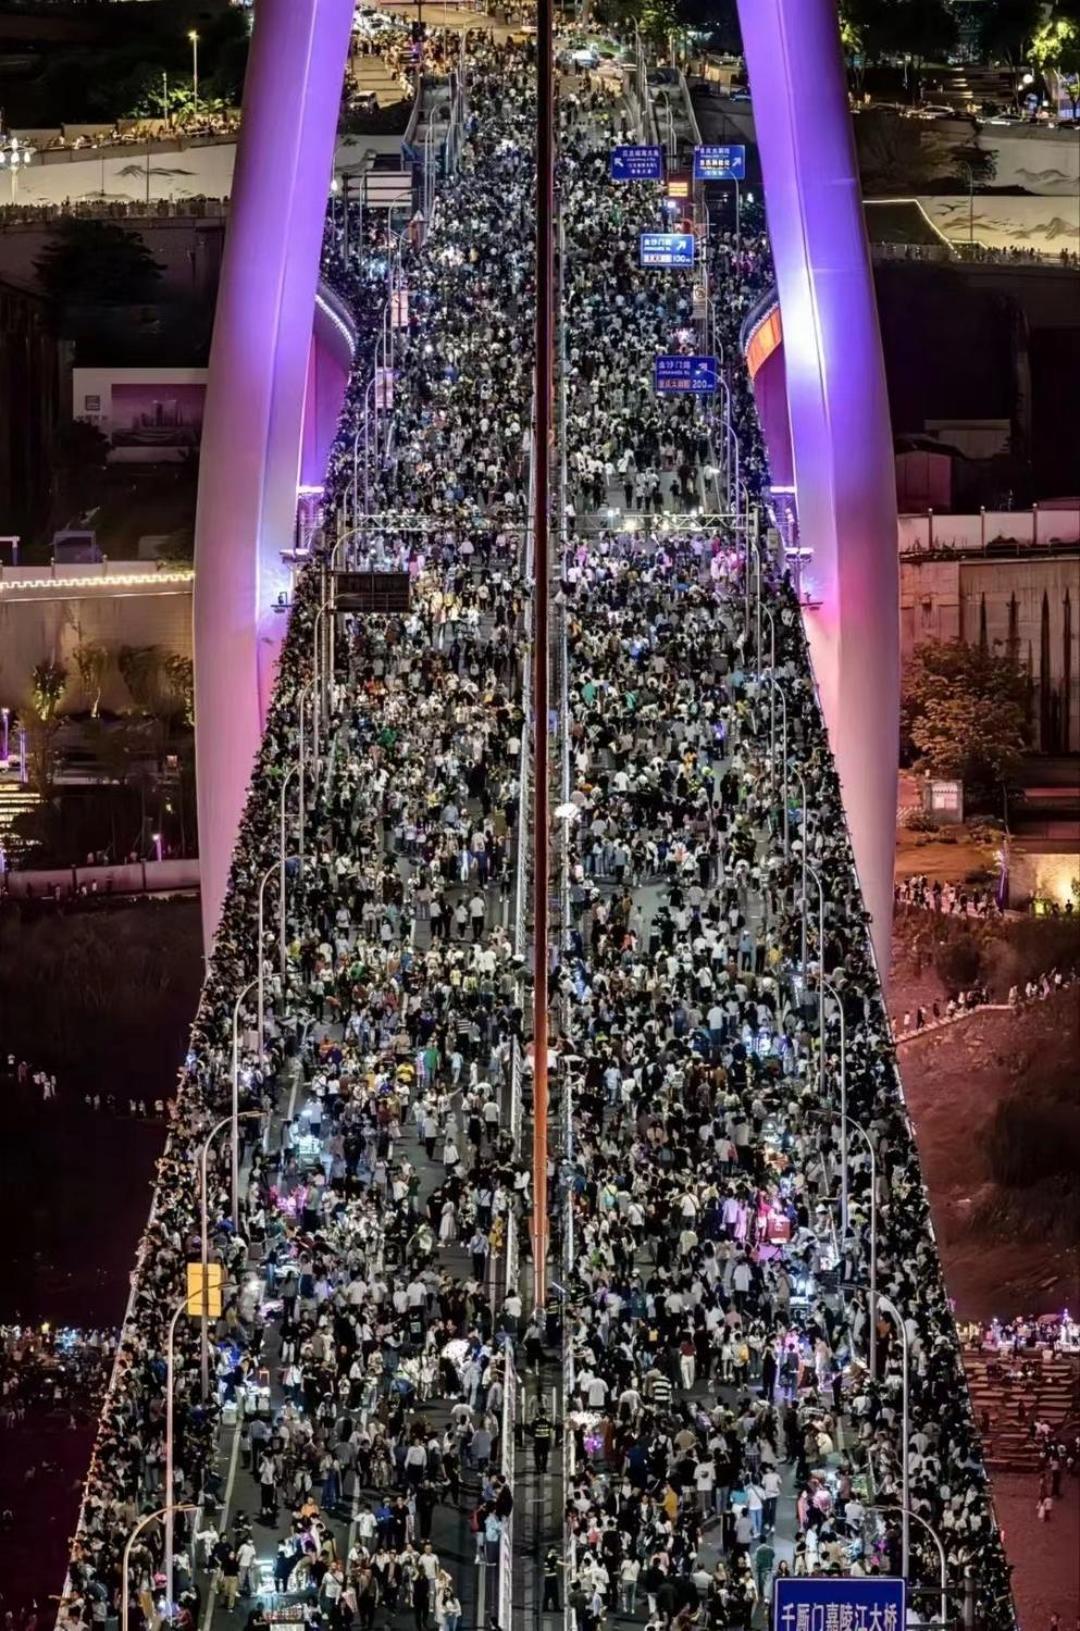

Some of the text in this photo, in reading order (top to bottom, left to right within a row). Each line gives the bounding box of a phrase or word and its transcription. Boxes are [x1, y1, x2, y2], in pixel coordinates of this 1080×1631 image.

[781, 1602, 897, 1631] 千厮门嘉陵江大桥
